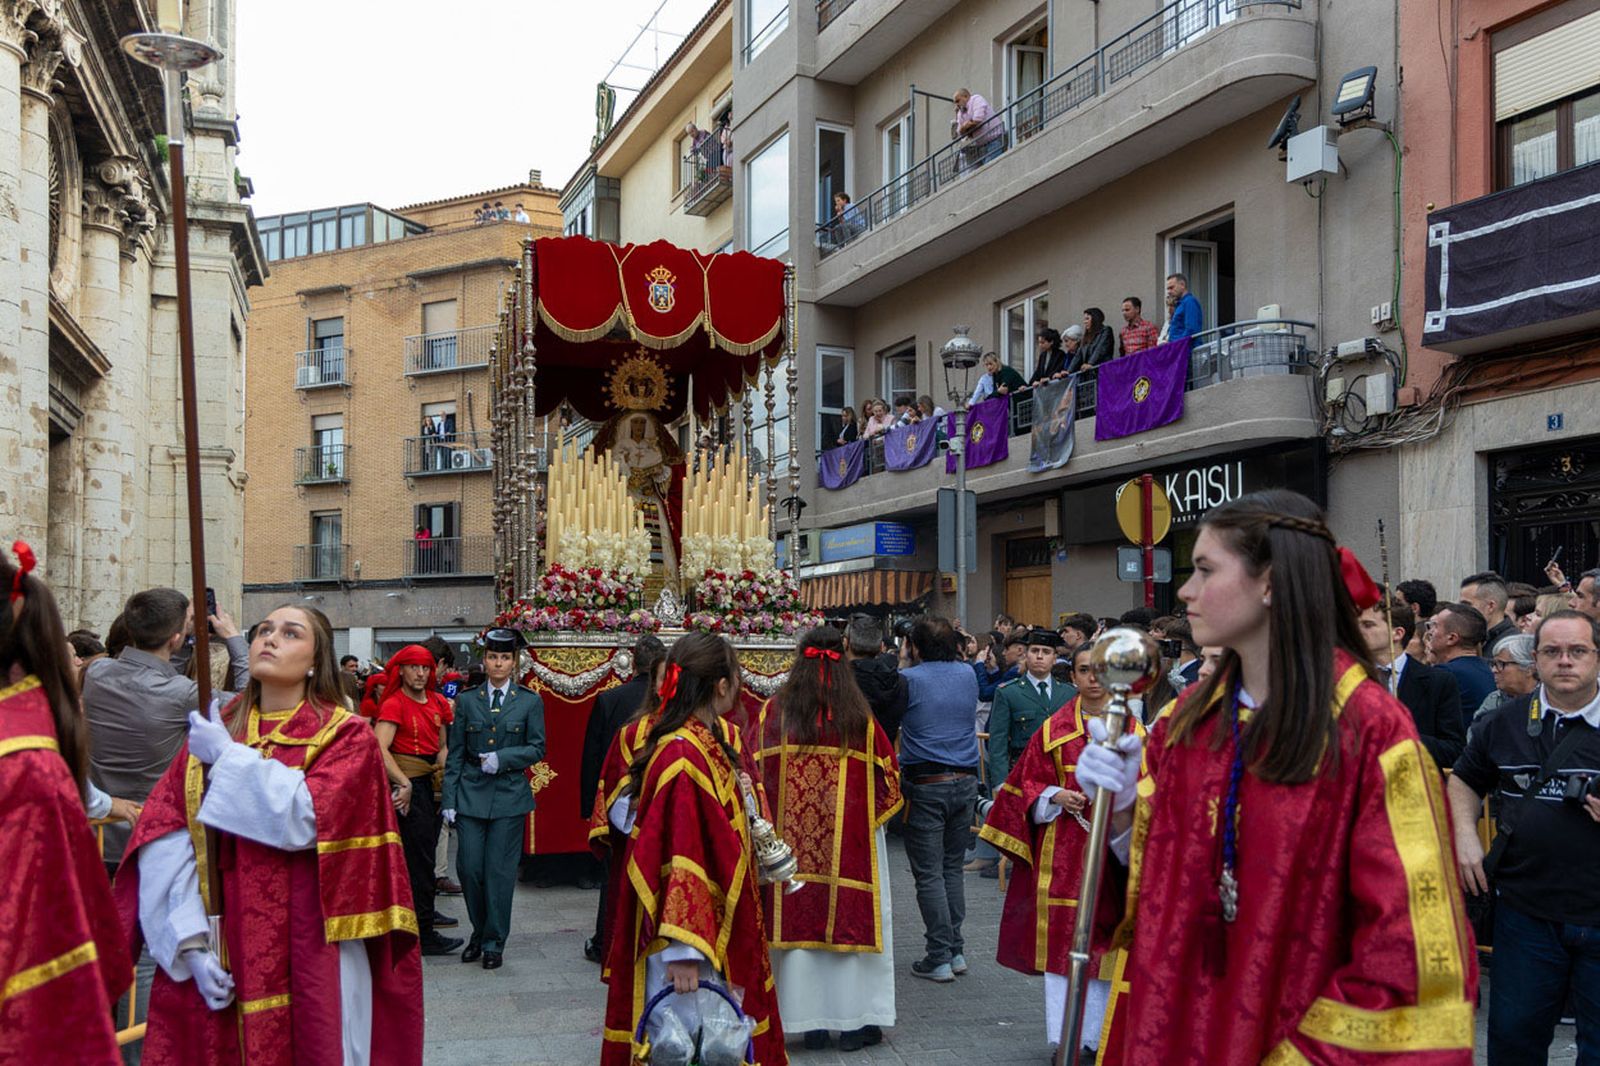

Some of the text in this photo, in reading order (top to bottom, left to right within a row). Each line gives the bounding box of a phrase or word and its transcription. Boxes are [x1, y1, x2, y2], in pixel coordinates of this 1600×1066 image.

[1551, 415, 1559, 429] 3
[1561, 456, 1571, 472] 3
[1165, 461, 1243, 513] KAISU
[1172, 514, 1197, 524] TASTY
